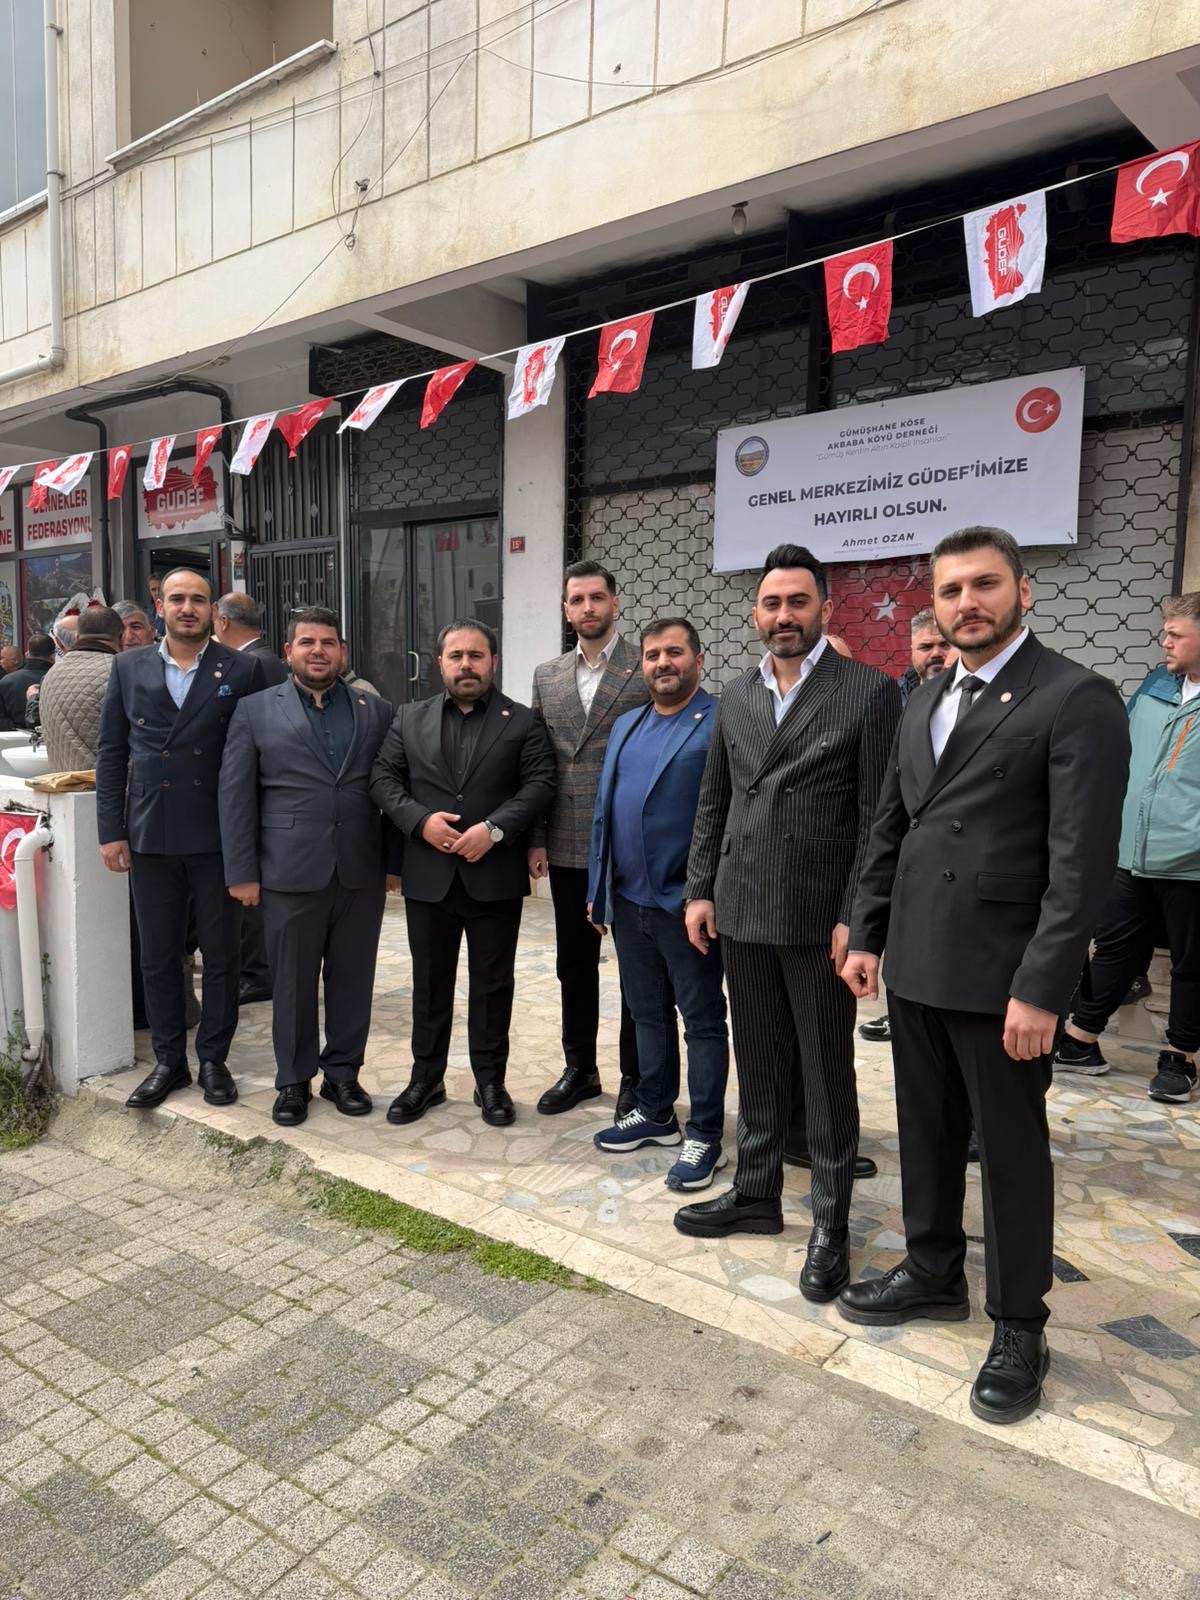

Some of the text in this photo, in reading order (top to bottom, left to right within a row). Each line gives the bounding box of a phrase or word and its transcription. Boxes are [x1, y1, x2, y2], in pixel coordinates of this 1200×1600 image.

[827, 424, 938, 450] AKBABA KÖYÜ DERNEĞİ
[839, 417, 926, 438] GÜMÜŞHANE KÖSE
[156, 488, 204, 512] GÜDEF
[748, 490, 796, 507] GENEL
[800, 472, 903, 500] MERKEZİMİZ
[814, 498, 947, 526] HAYIRLI OLSUN.
[842, 532, 915, 547] Ahmet OZAN
